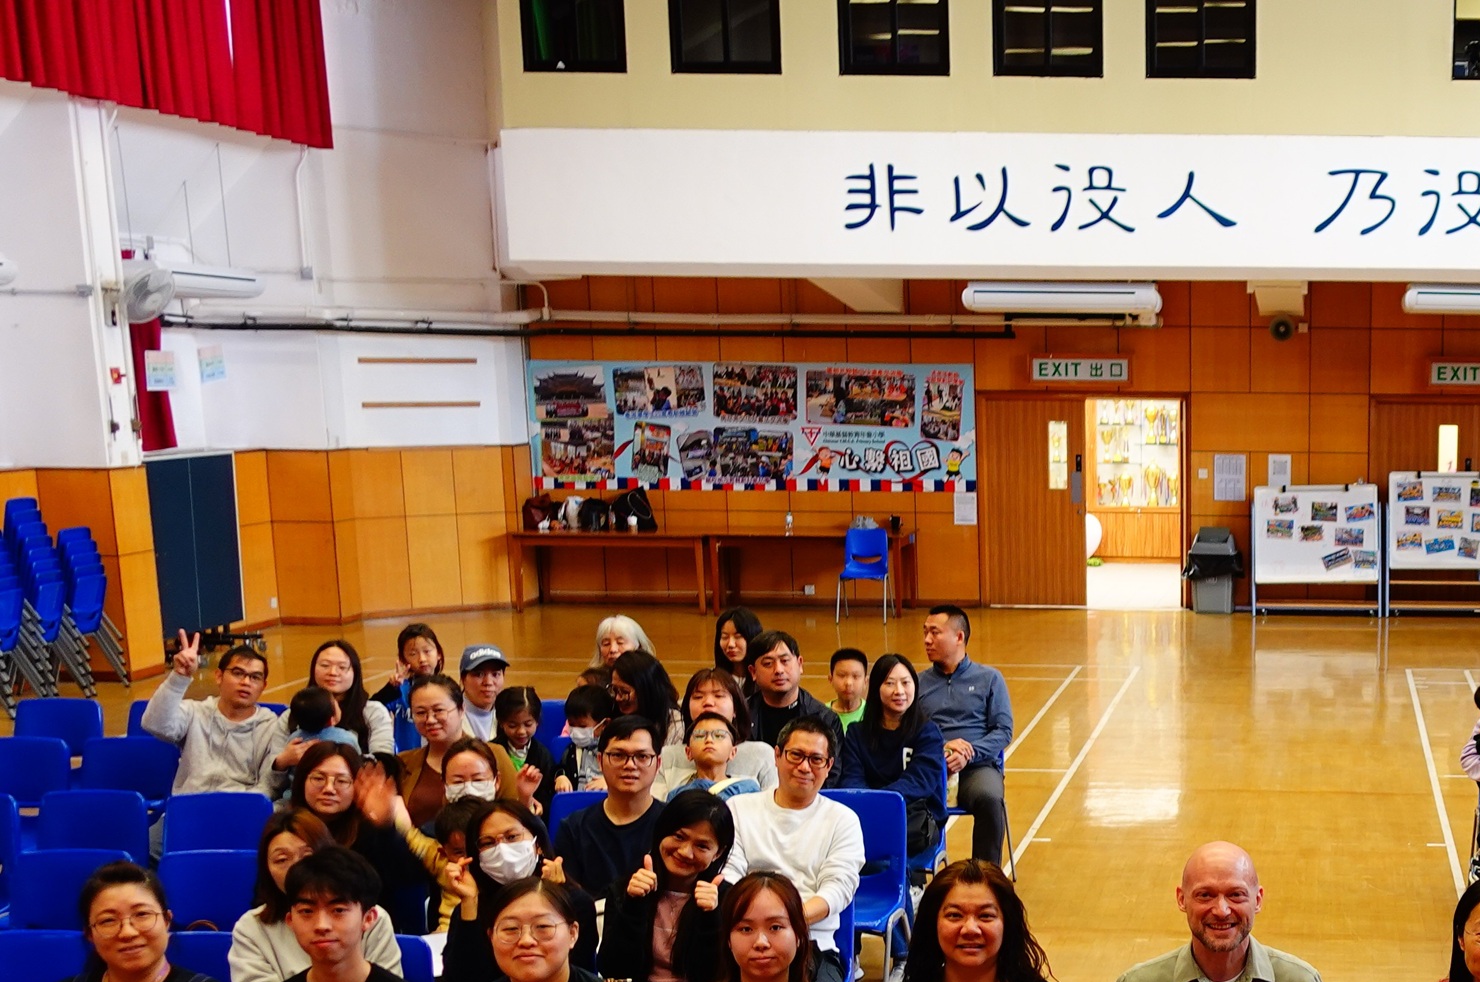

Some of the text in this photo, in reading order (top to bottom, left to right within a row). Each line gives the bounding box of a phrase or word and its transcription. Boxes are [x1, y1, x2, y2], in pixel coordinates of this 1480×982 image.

[1039, 362, 1122, 377] EXIT 出口
[1437, 366, 1479, 381] EXIT
[840, 447, 940, 472] 心繫祖國
[903, 747, 913, 771] F
